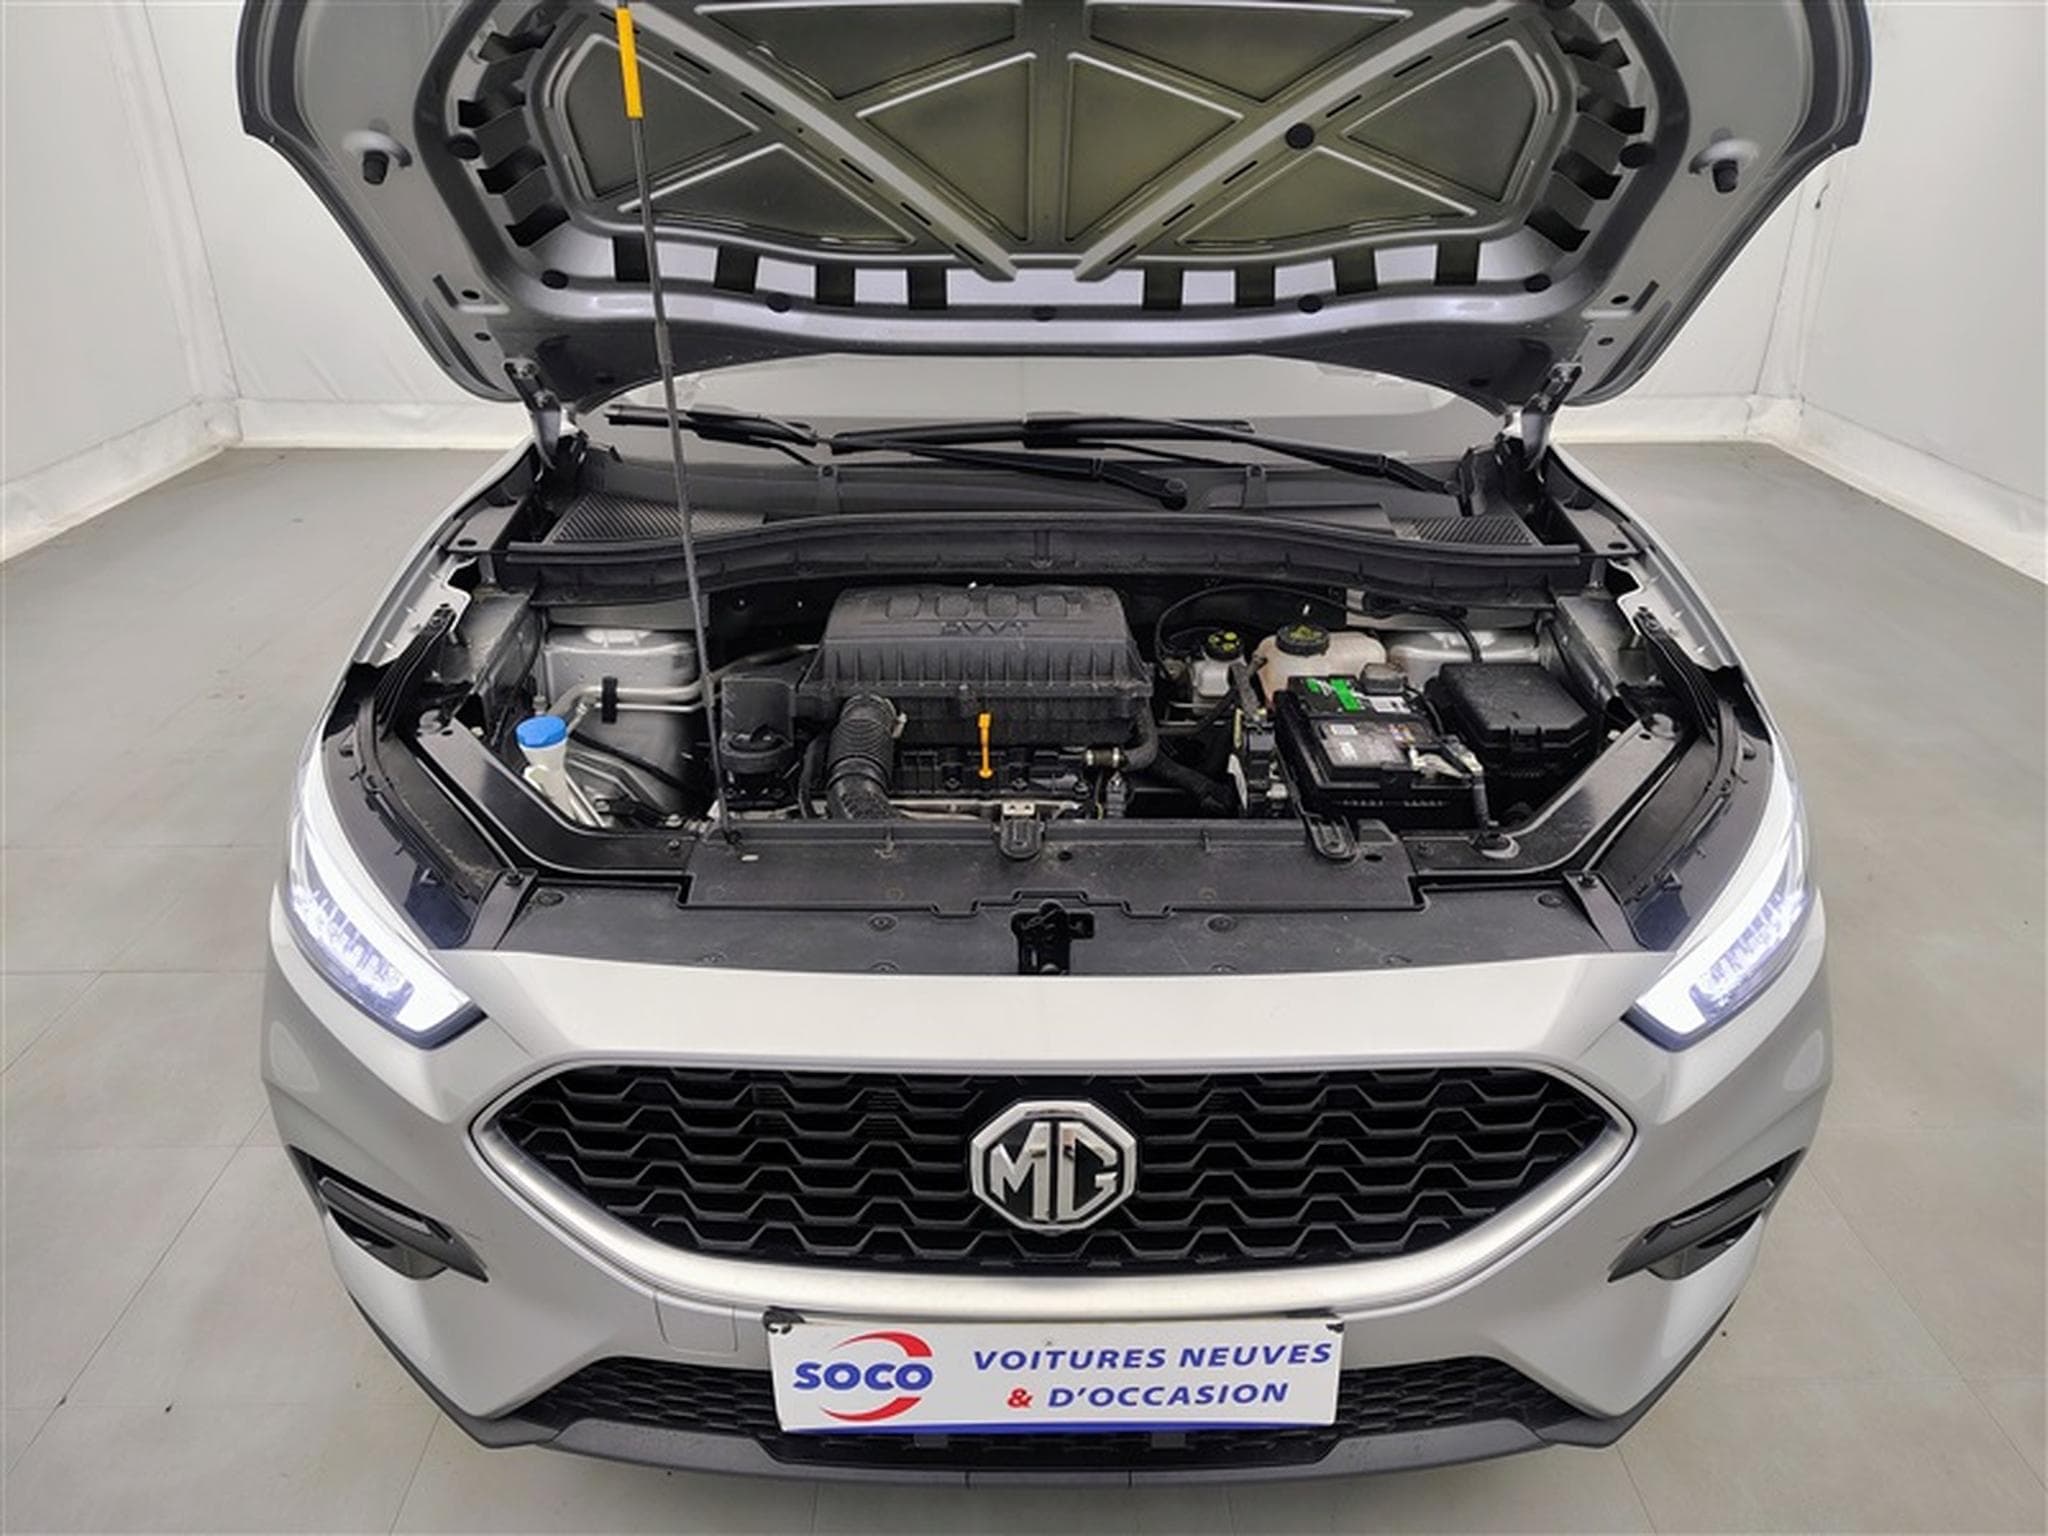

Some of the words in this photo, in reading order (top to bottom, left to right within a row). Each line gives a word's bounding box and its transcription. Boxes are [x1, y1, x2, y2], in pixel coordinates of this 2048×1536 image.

[990, 1121, 1118, 1212] MG
[975, 1350, 1164, 1371] VOITURES
[1180, 1344, 1331, 1368] NEUVES
[794, 1361, 934, 1391] SOCO
[1007, 1387, 1032, 1409] &
[1049, 1382, 1288, 1408] D'OCCASION
